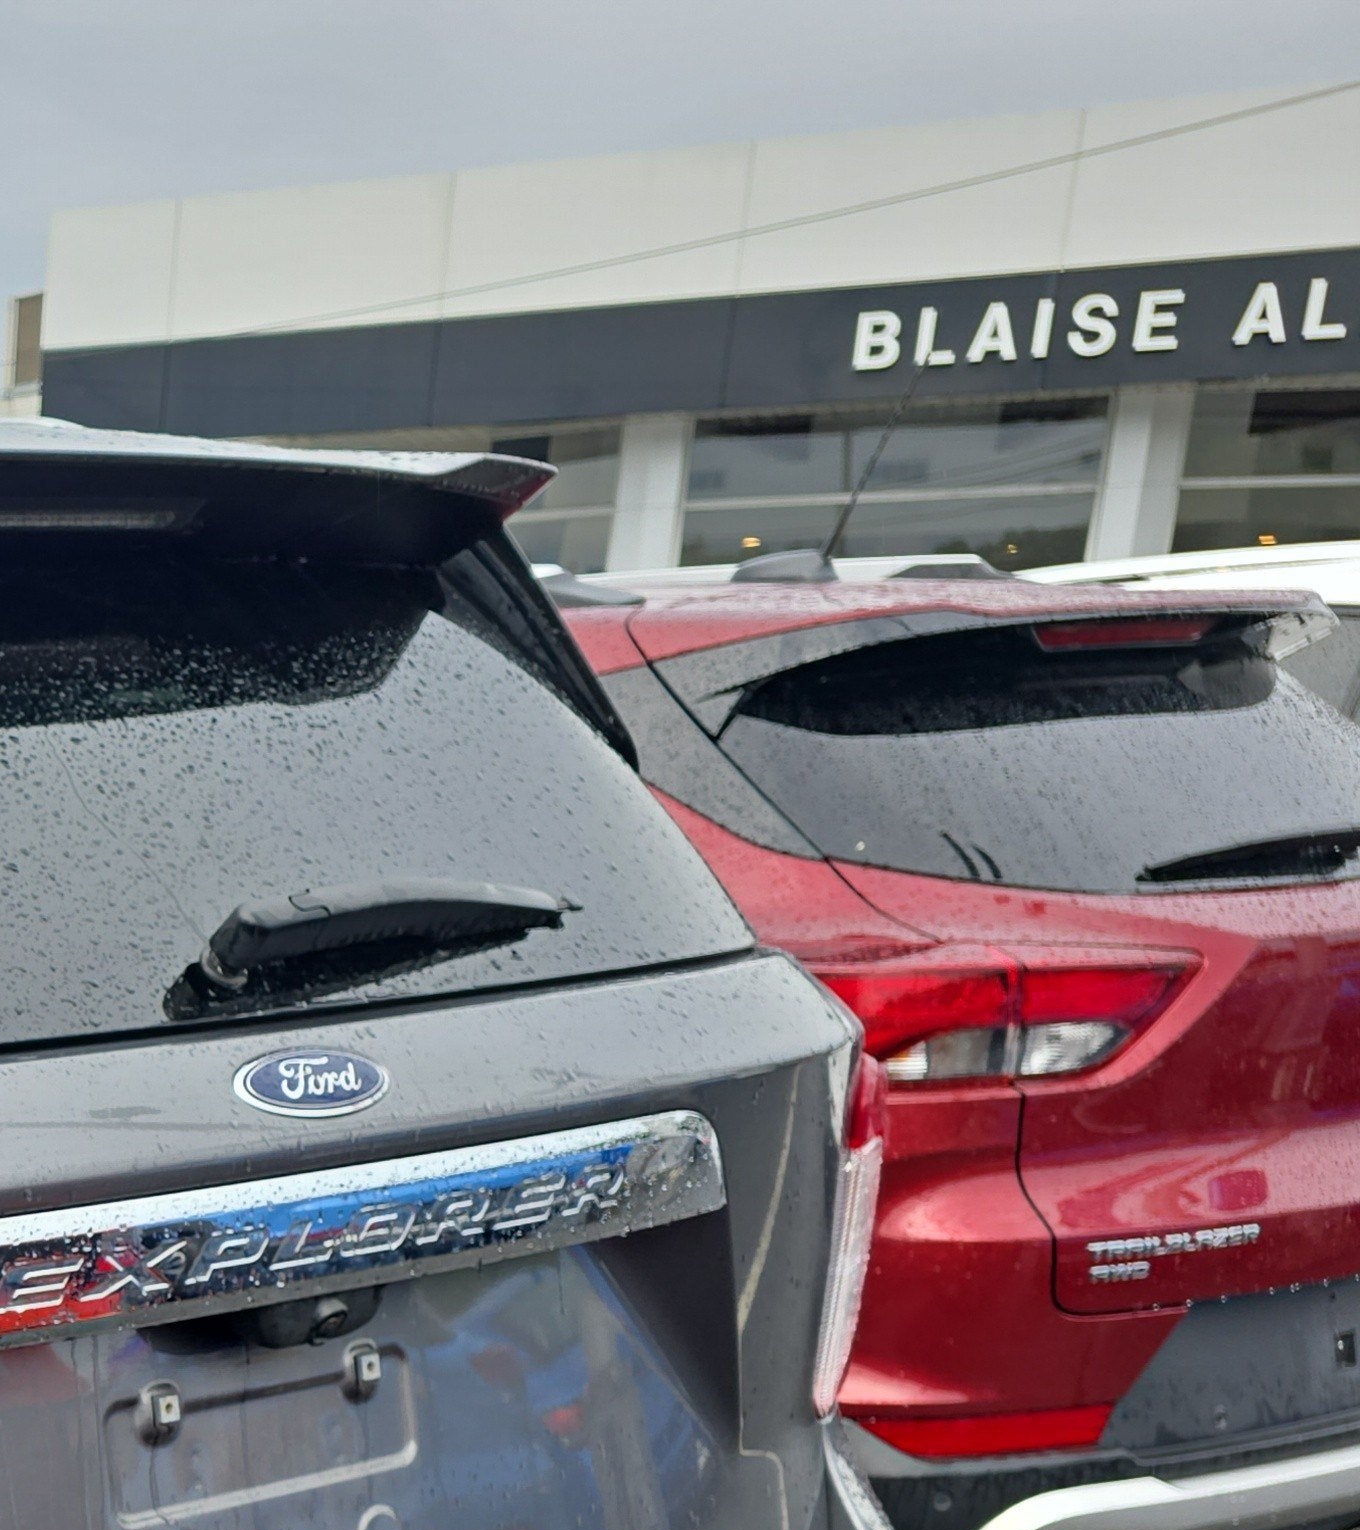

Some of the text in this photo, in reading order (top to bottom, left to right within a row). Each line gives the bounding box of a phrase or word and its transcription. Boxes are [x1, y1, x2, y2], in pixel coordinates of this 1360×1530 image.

[851, 277, 1347, 371] BLAISE AL
[278, 1056, 362, 1099] Ford
